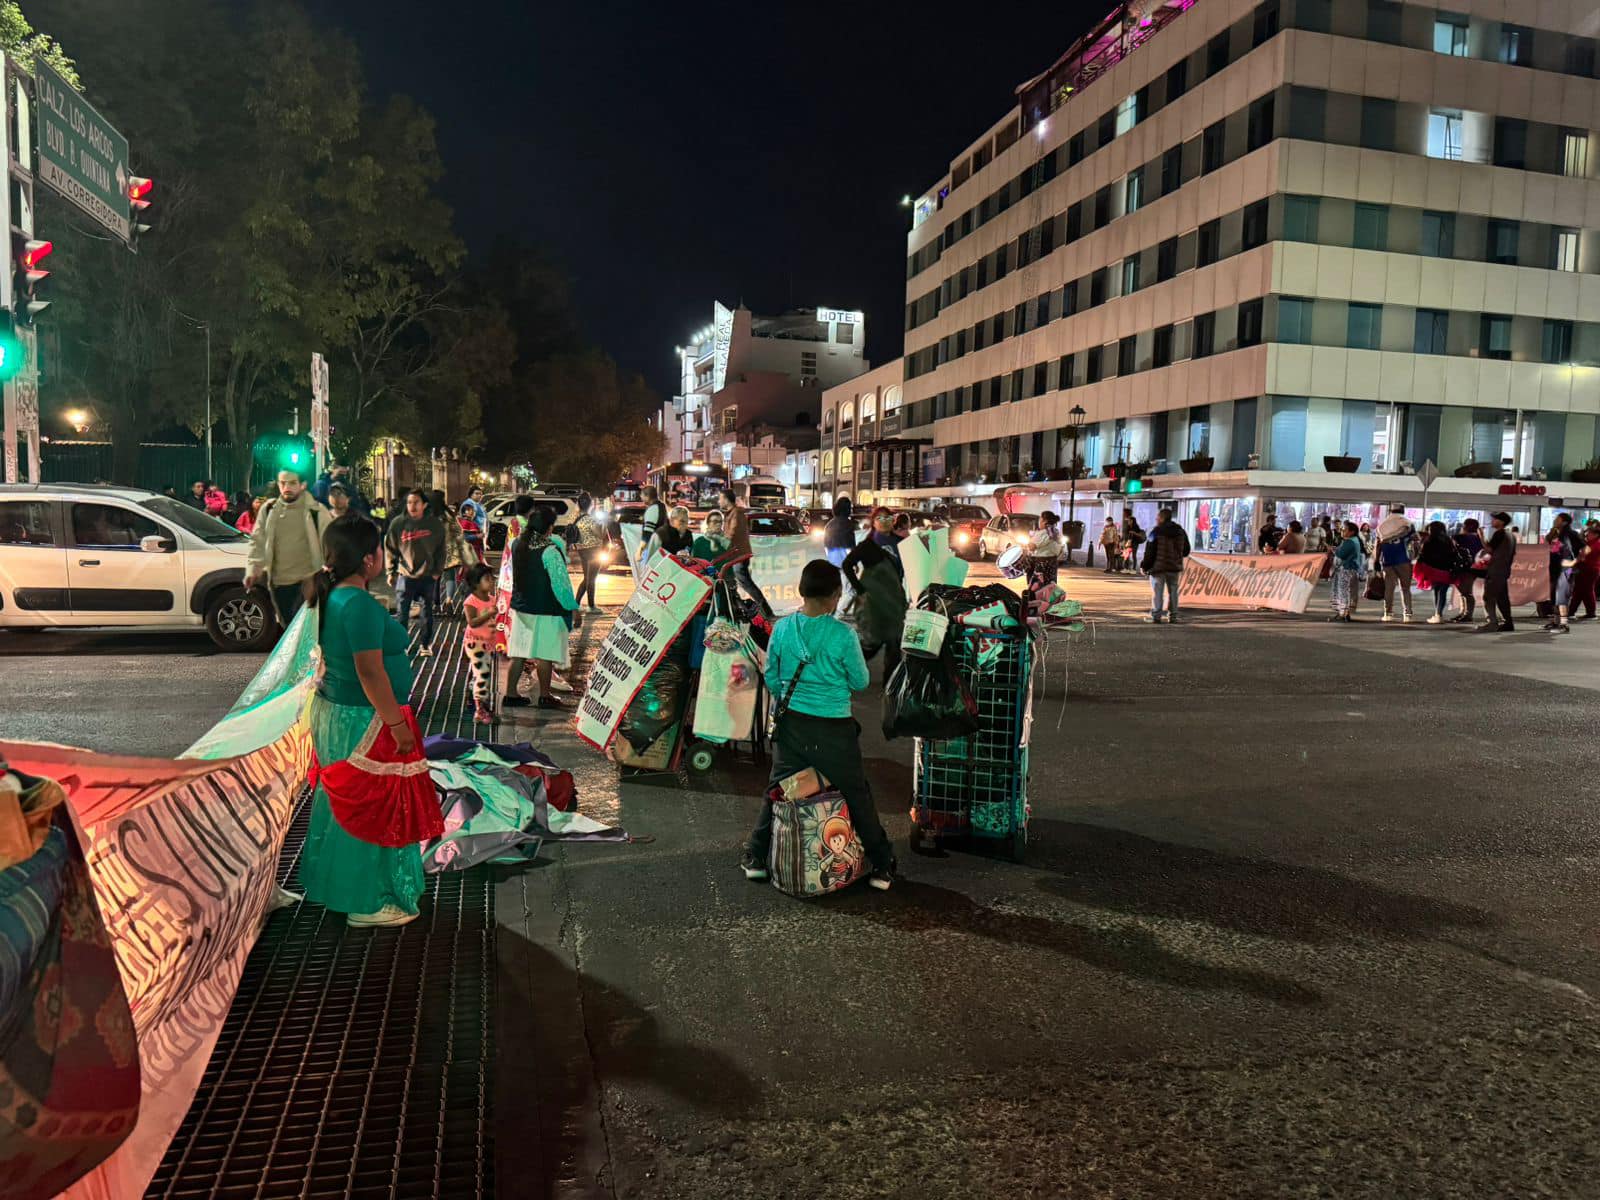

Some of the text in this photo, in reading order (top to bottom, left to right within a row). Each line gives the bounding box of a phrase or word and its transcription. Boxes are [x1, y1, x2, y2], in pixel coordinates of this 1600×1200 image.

[39, 74, 114, 163] CALZ. LOS ARCOS
[66, 178, 122, 231] CORREGIDORA
[820, 311, 861, 323] HOTEL
[716, 322, 727, 350] REAL
[604, 646, 632, 682] Nuestro
[613, 627, 638, 656] Contra
[634, 645, 656, 668] Del
[602, 681, 613, 698] y
